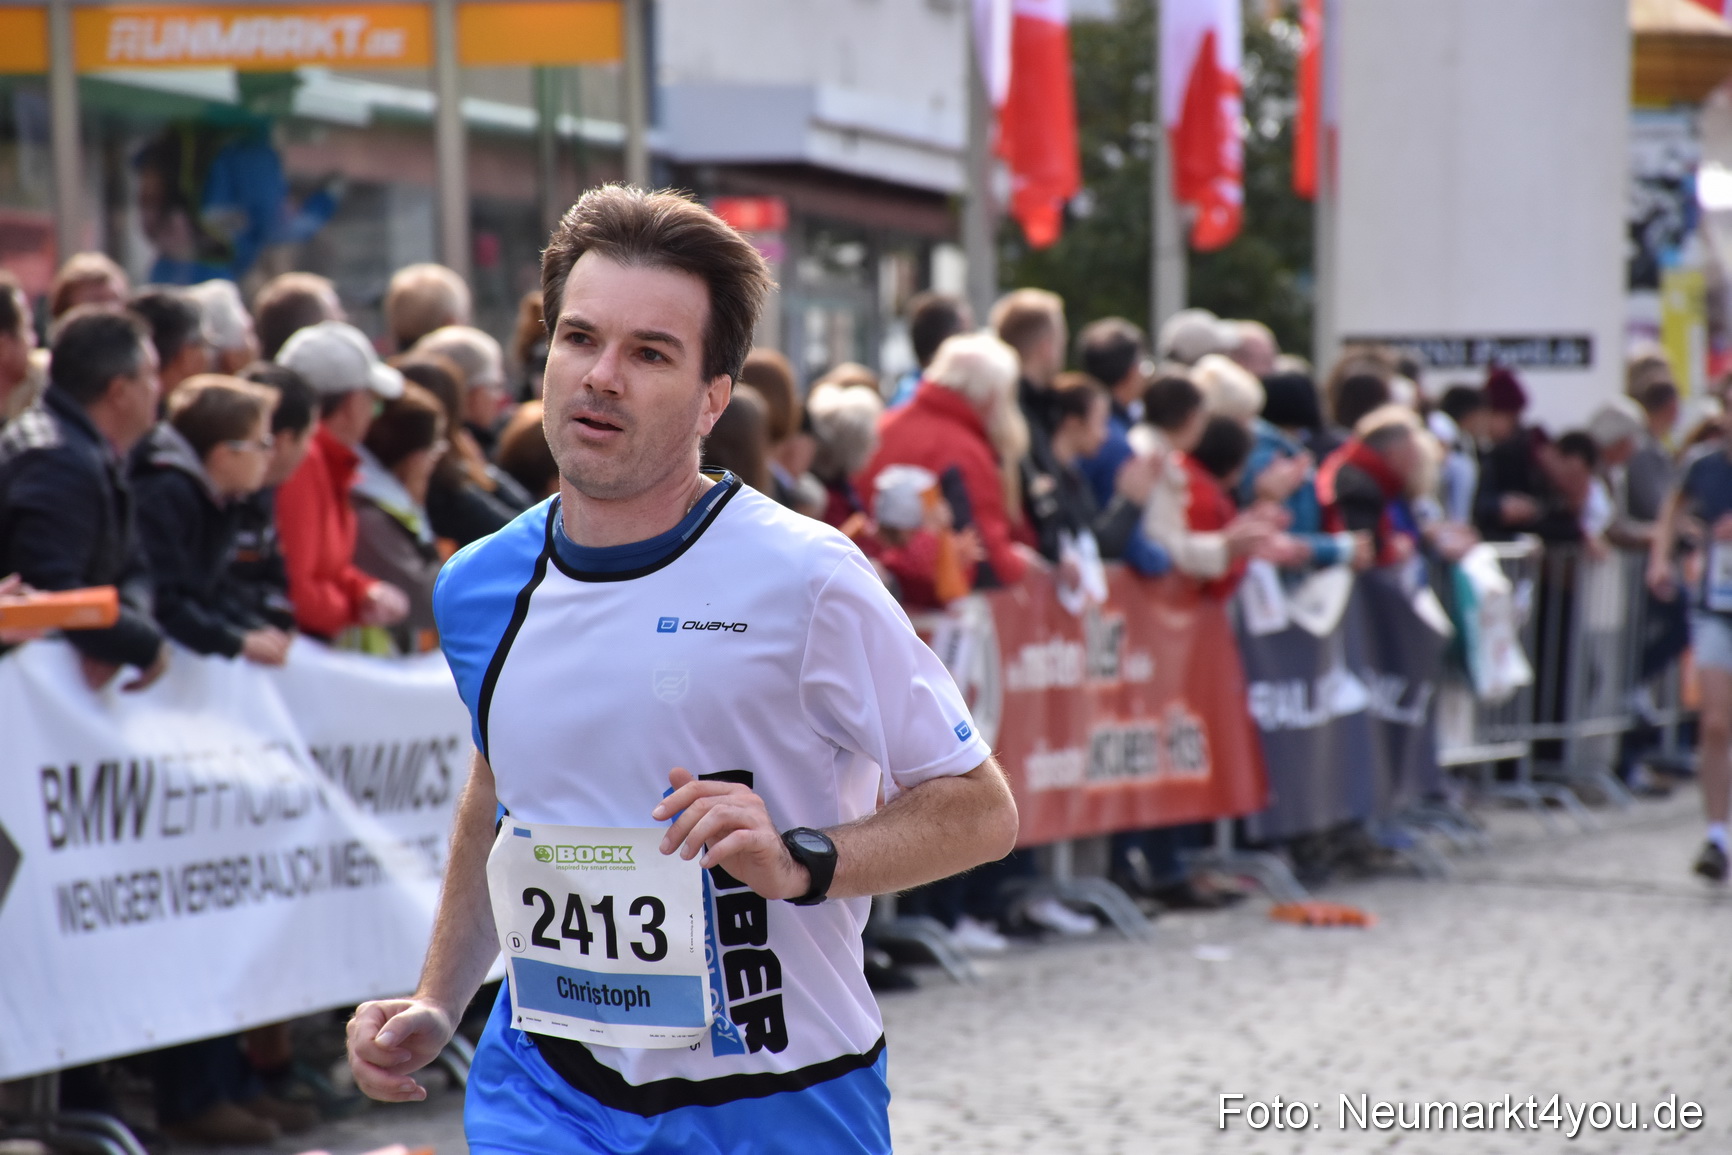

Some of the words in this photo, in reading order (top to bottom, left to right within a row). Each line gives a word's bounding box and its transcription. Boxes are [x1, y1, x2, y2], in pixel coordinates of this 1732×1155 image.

[40, 755, 155, 851] BMW
[556, 845, 635, 863] BOCK
[512, 937, 521, 949] D
[522, 887, 668, 963] 2413
[556, 975, 651, 1012] Christoph
